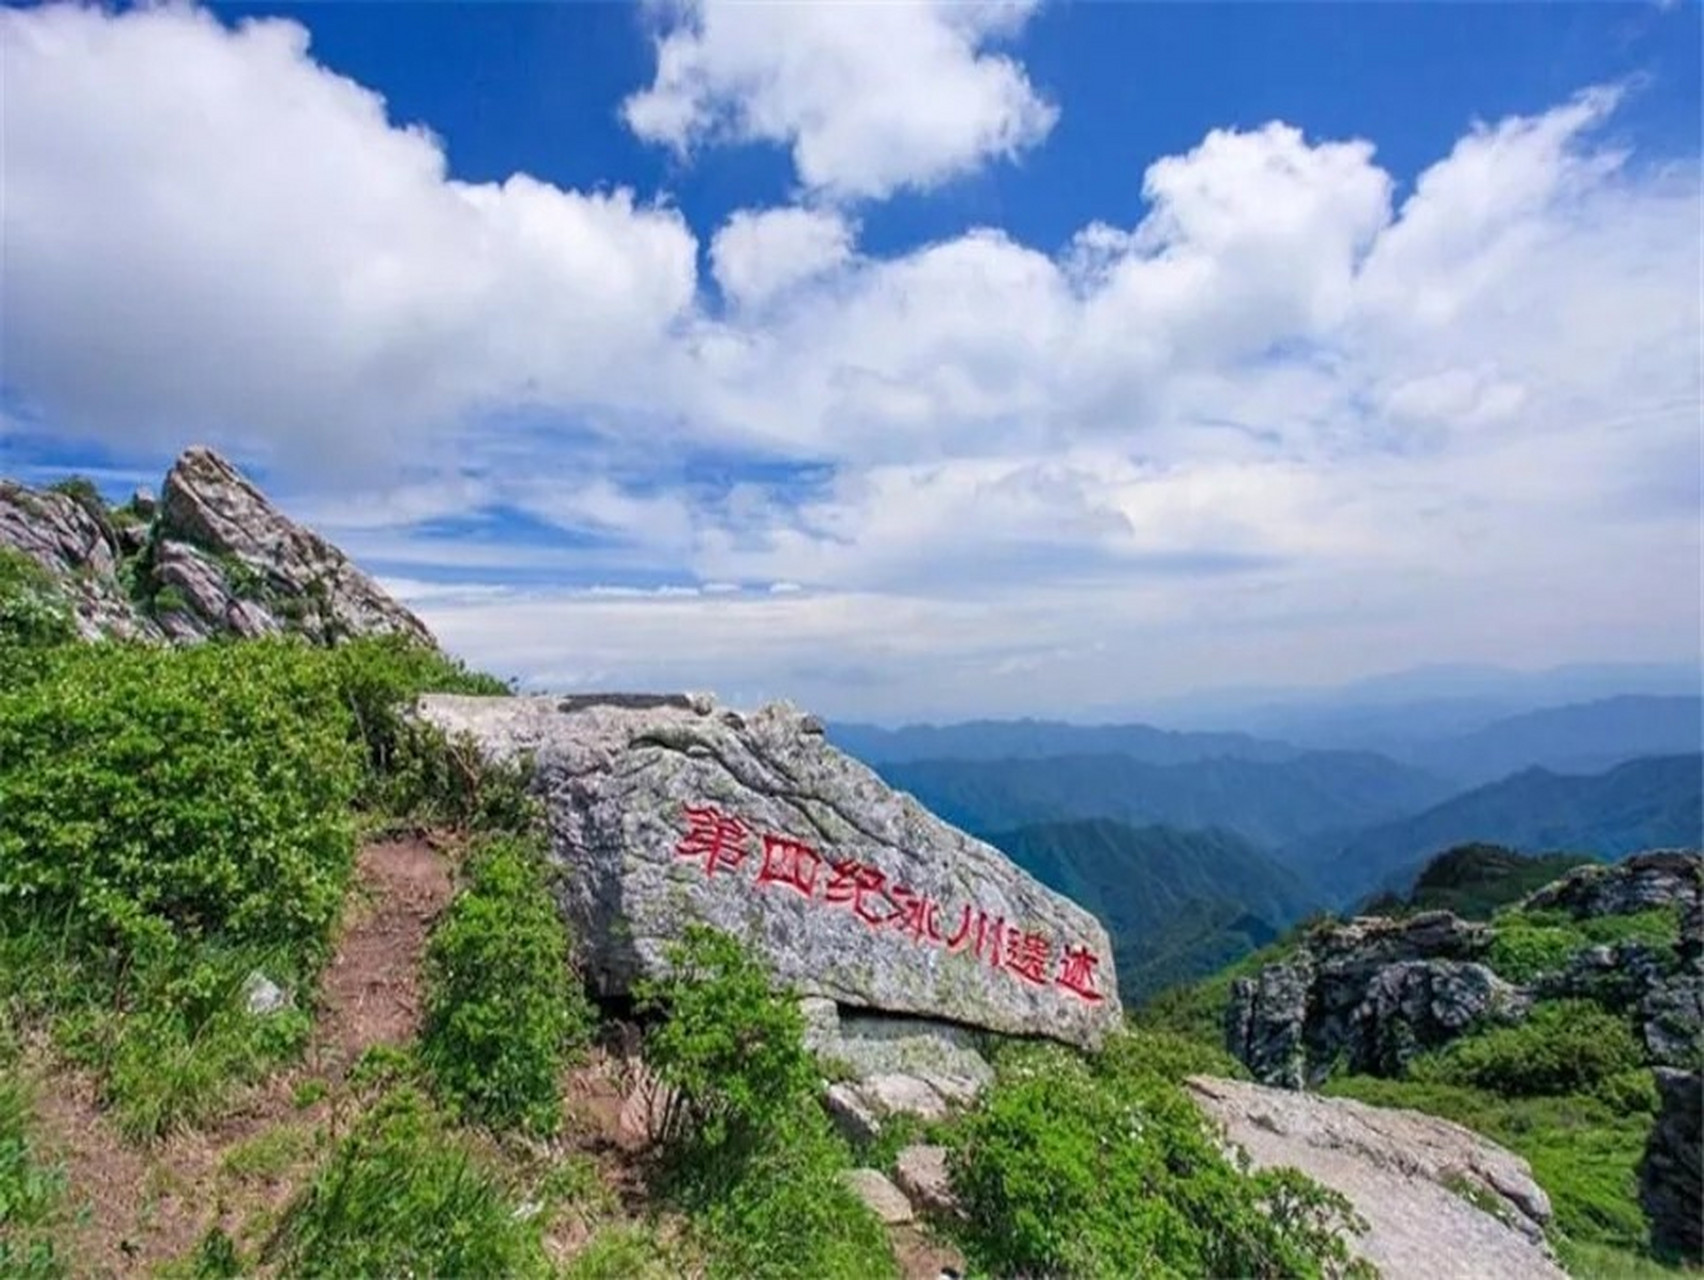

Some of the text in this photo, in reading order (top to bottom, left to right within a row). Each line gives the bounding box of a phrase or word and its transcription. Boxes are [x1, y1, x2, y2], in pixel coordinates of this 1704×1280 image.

[676, 803, 1104, 1003] 第四纪冰川遗迹
